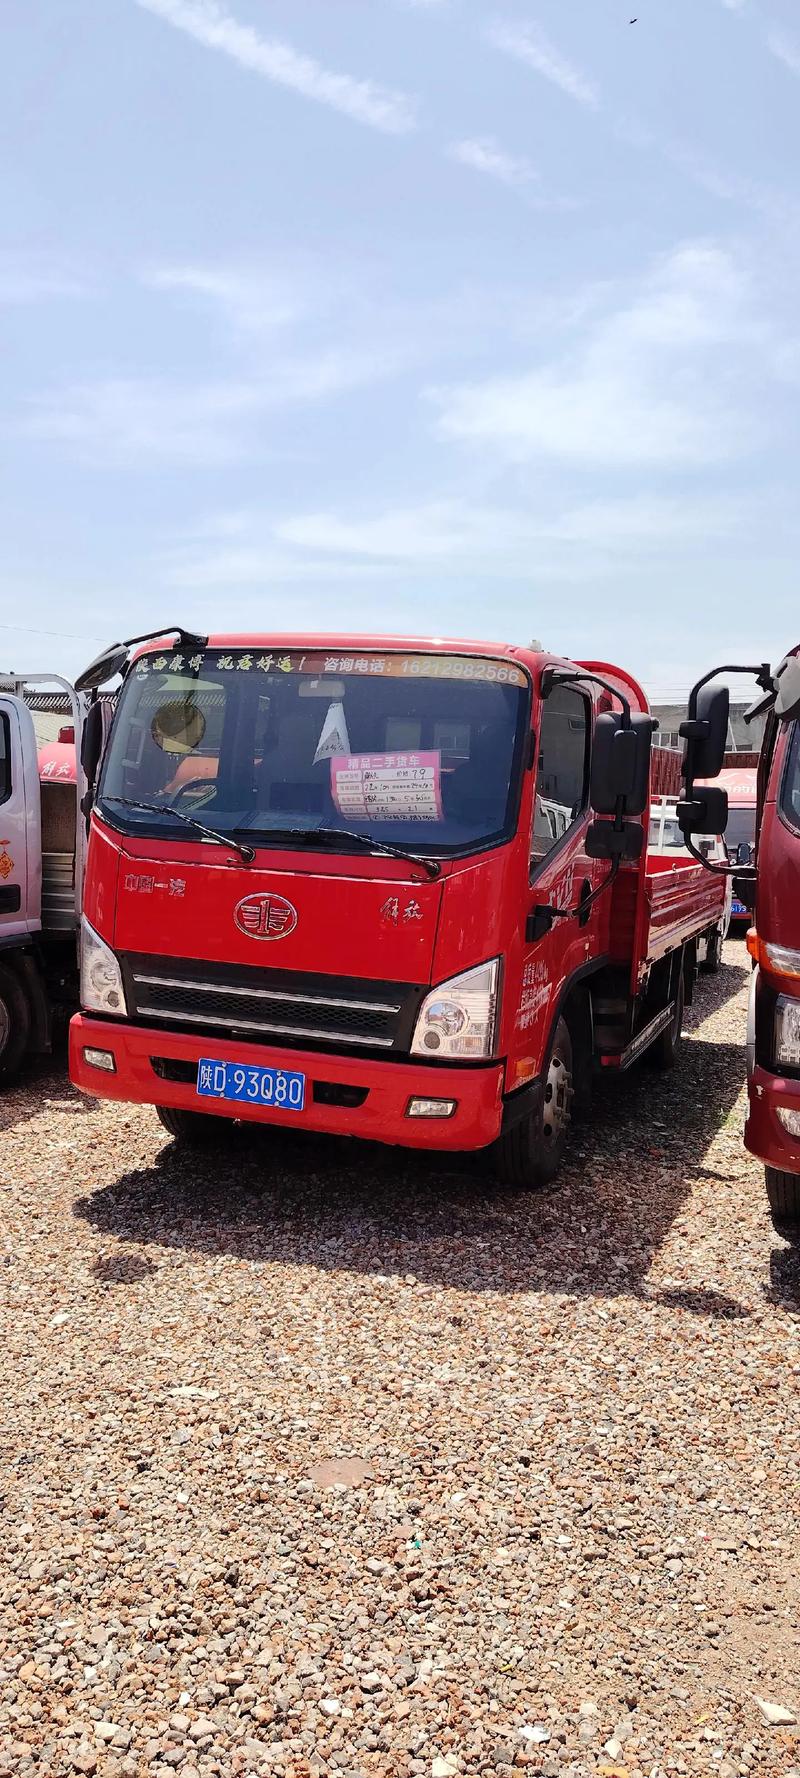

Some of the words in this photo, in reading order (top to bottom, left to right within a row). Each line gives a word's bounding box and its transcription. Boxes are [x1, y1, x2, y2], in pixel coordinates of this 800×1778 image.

[347, 755, 420, 769] 精品二手货车
[124, 874, 186, 897] 中国一汽
[380, 897, 424, 926] 解放
[200, 1065, 301, 1104] 陕D·93Q80
